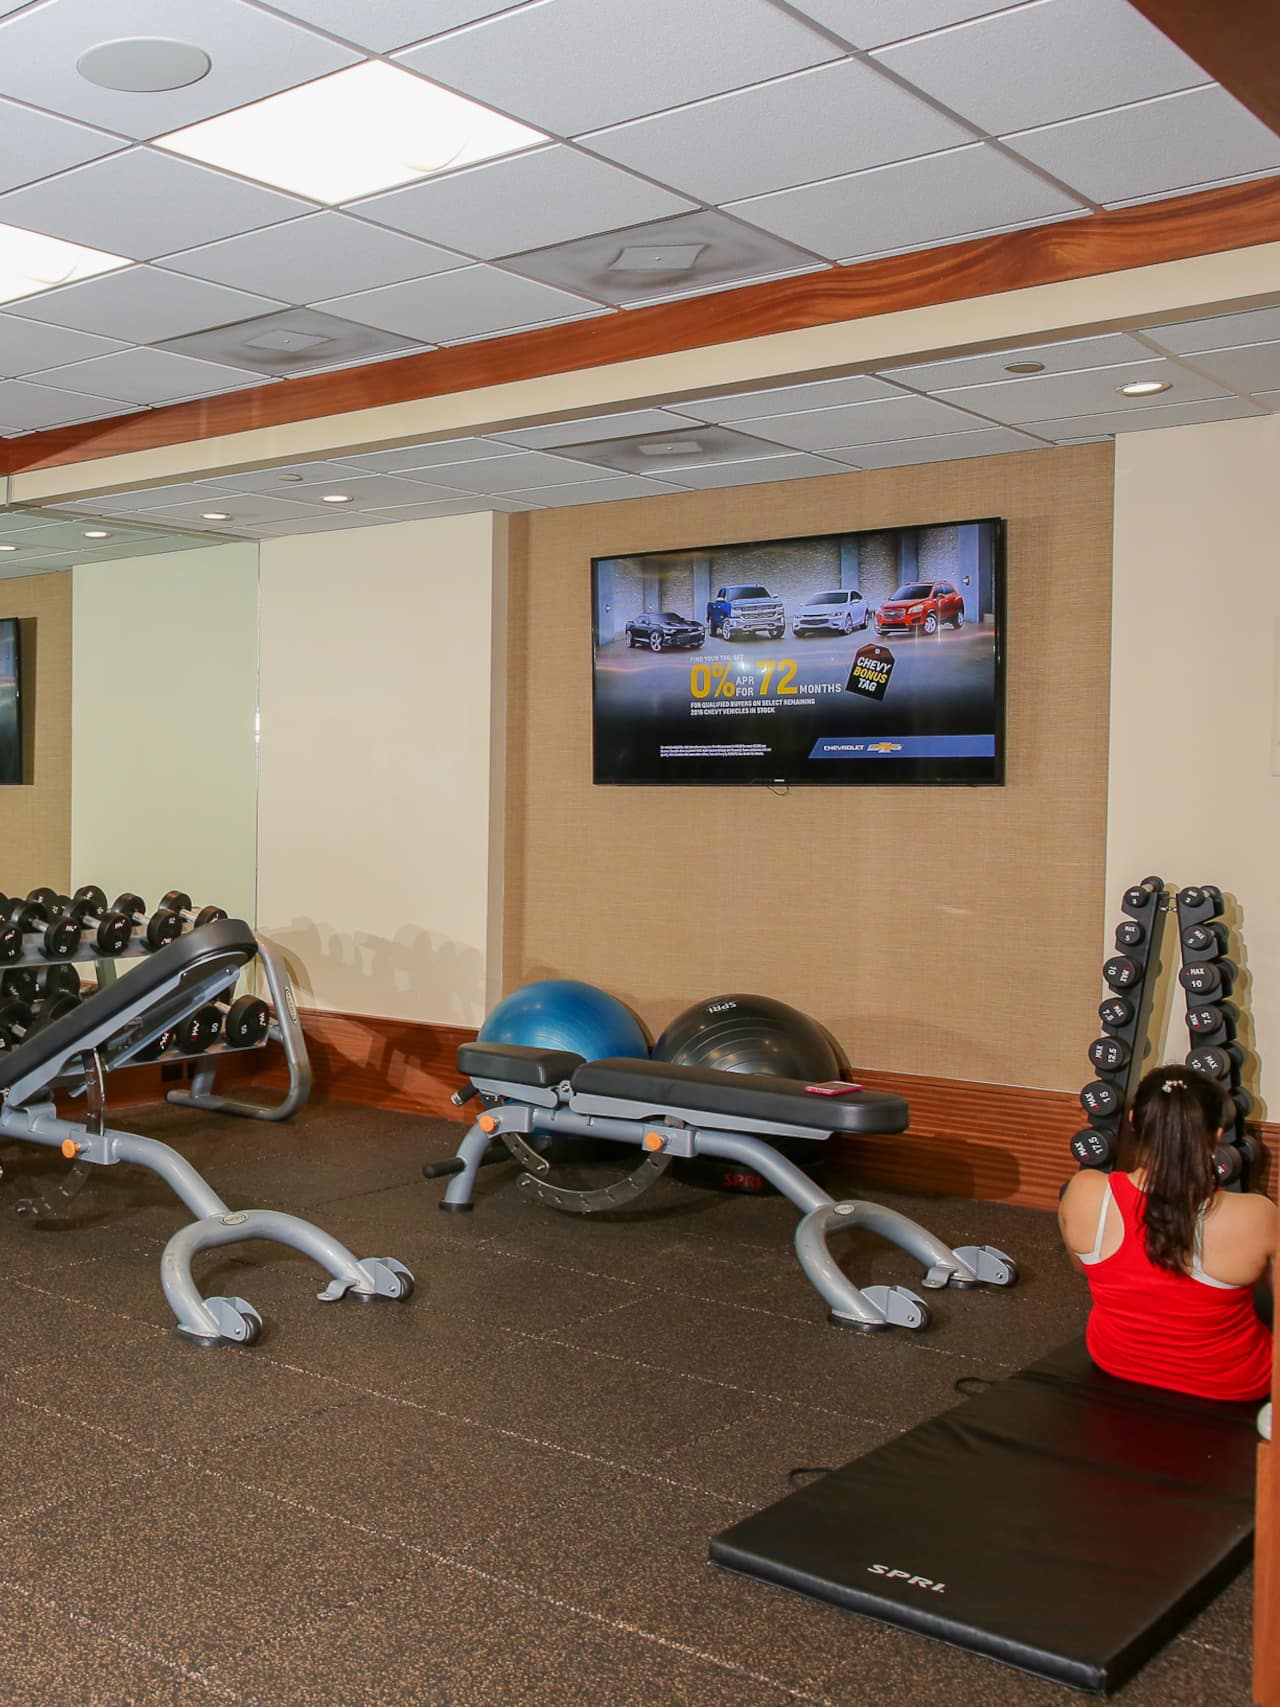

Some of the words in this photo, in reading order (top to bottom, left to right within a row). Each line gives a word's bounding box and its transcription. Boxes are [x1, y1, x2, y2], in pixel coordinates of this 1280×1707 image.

[856, 656, 891, 673] CHEVY
[690, 662, 736, 699] 0%
[736, 676, 754, 686] APR
[755, 658, 798, 695] 72
[853, 666, 888, 684] BONUS
[800, 683, 842, 694] MONTHS
[857, 678, 877, 692] TAG
[736, 687, 754, 697] FOR
[702, 701, 729, 709] QUALIFIED
[762, 699, 783, 707] SELECT
[723, 707, 749, 715] VEHICLES
[757, 706, 776, 714] STOCK
[1108, 966, 1117, 975] 10
[1190, 968, 1206, 976] MAX
[1192, 980, 1203, 988] 10
[1102, 1008, 1115, 1021] 7.5
[1108, 1048, 1117, 1063] 12.5
[1100, 1091, 1111, 1103] 15
[1088, 1136, 1104, 1154] 17.5
[724, 1173, 763, 1188] SPRI
